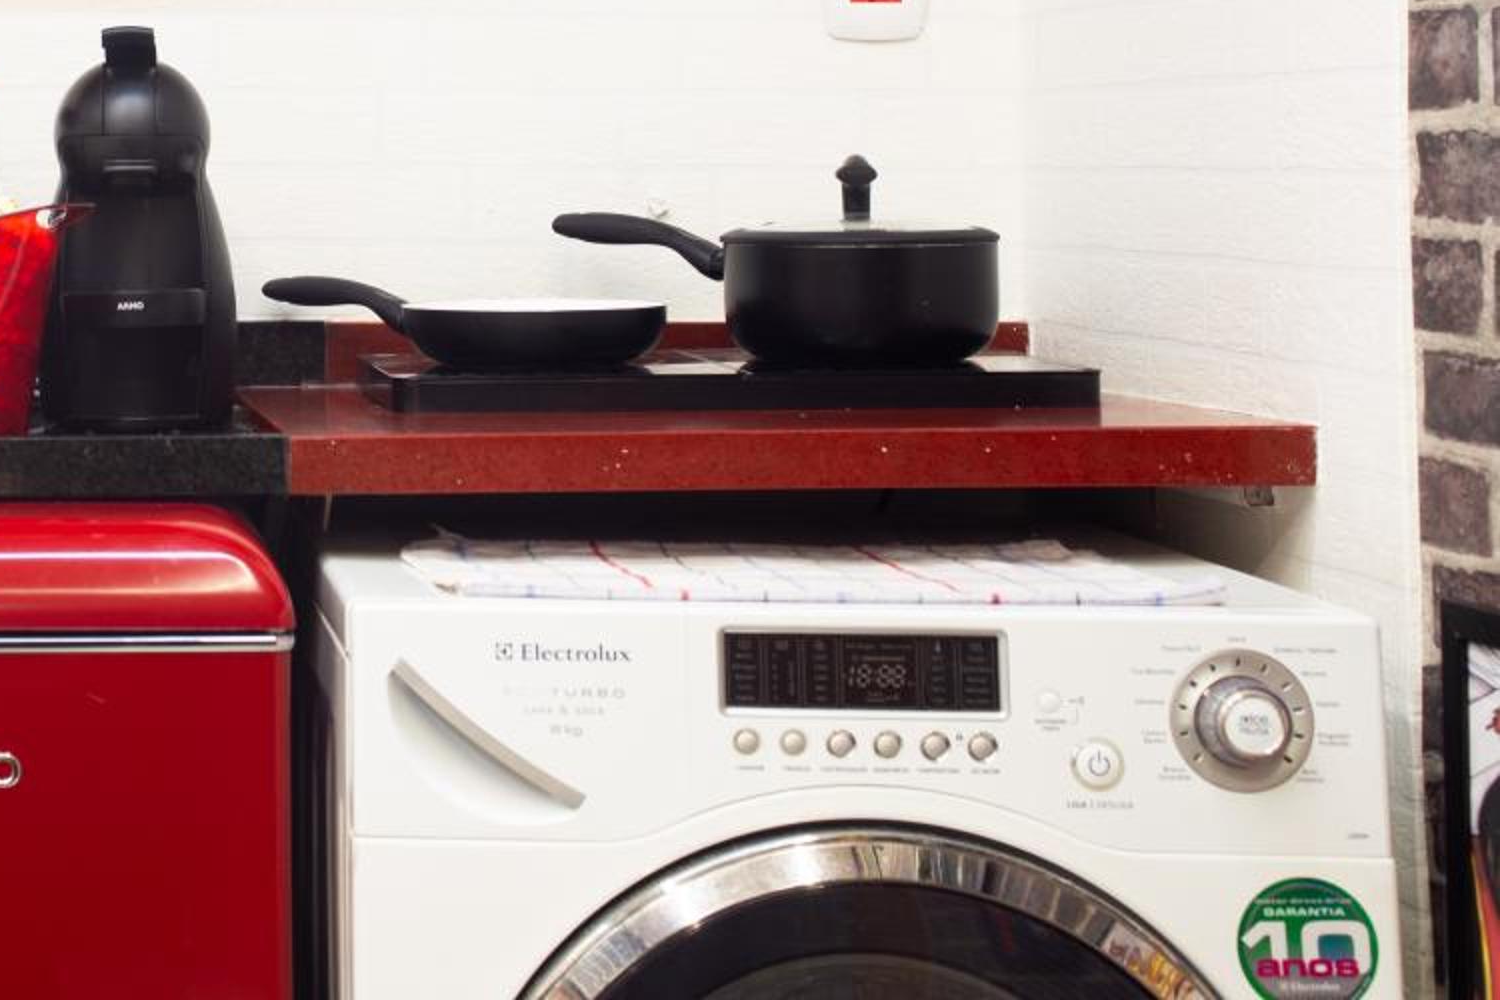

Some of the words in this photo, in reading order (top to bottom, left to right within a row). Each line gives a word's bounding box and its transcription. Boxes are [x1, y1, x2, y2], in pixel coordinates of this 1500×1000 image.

[521, 642, 632, 661] Electrolux
[1263, 907, 1345, 918] GARANTIA
[1241, 921, 1372, 974] 10
[1256, 958, 1359, 978] anos
